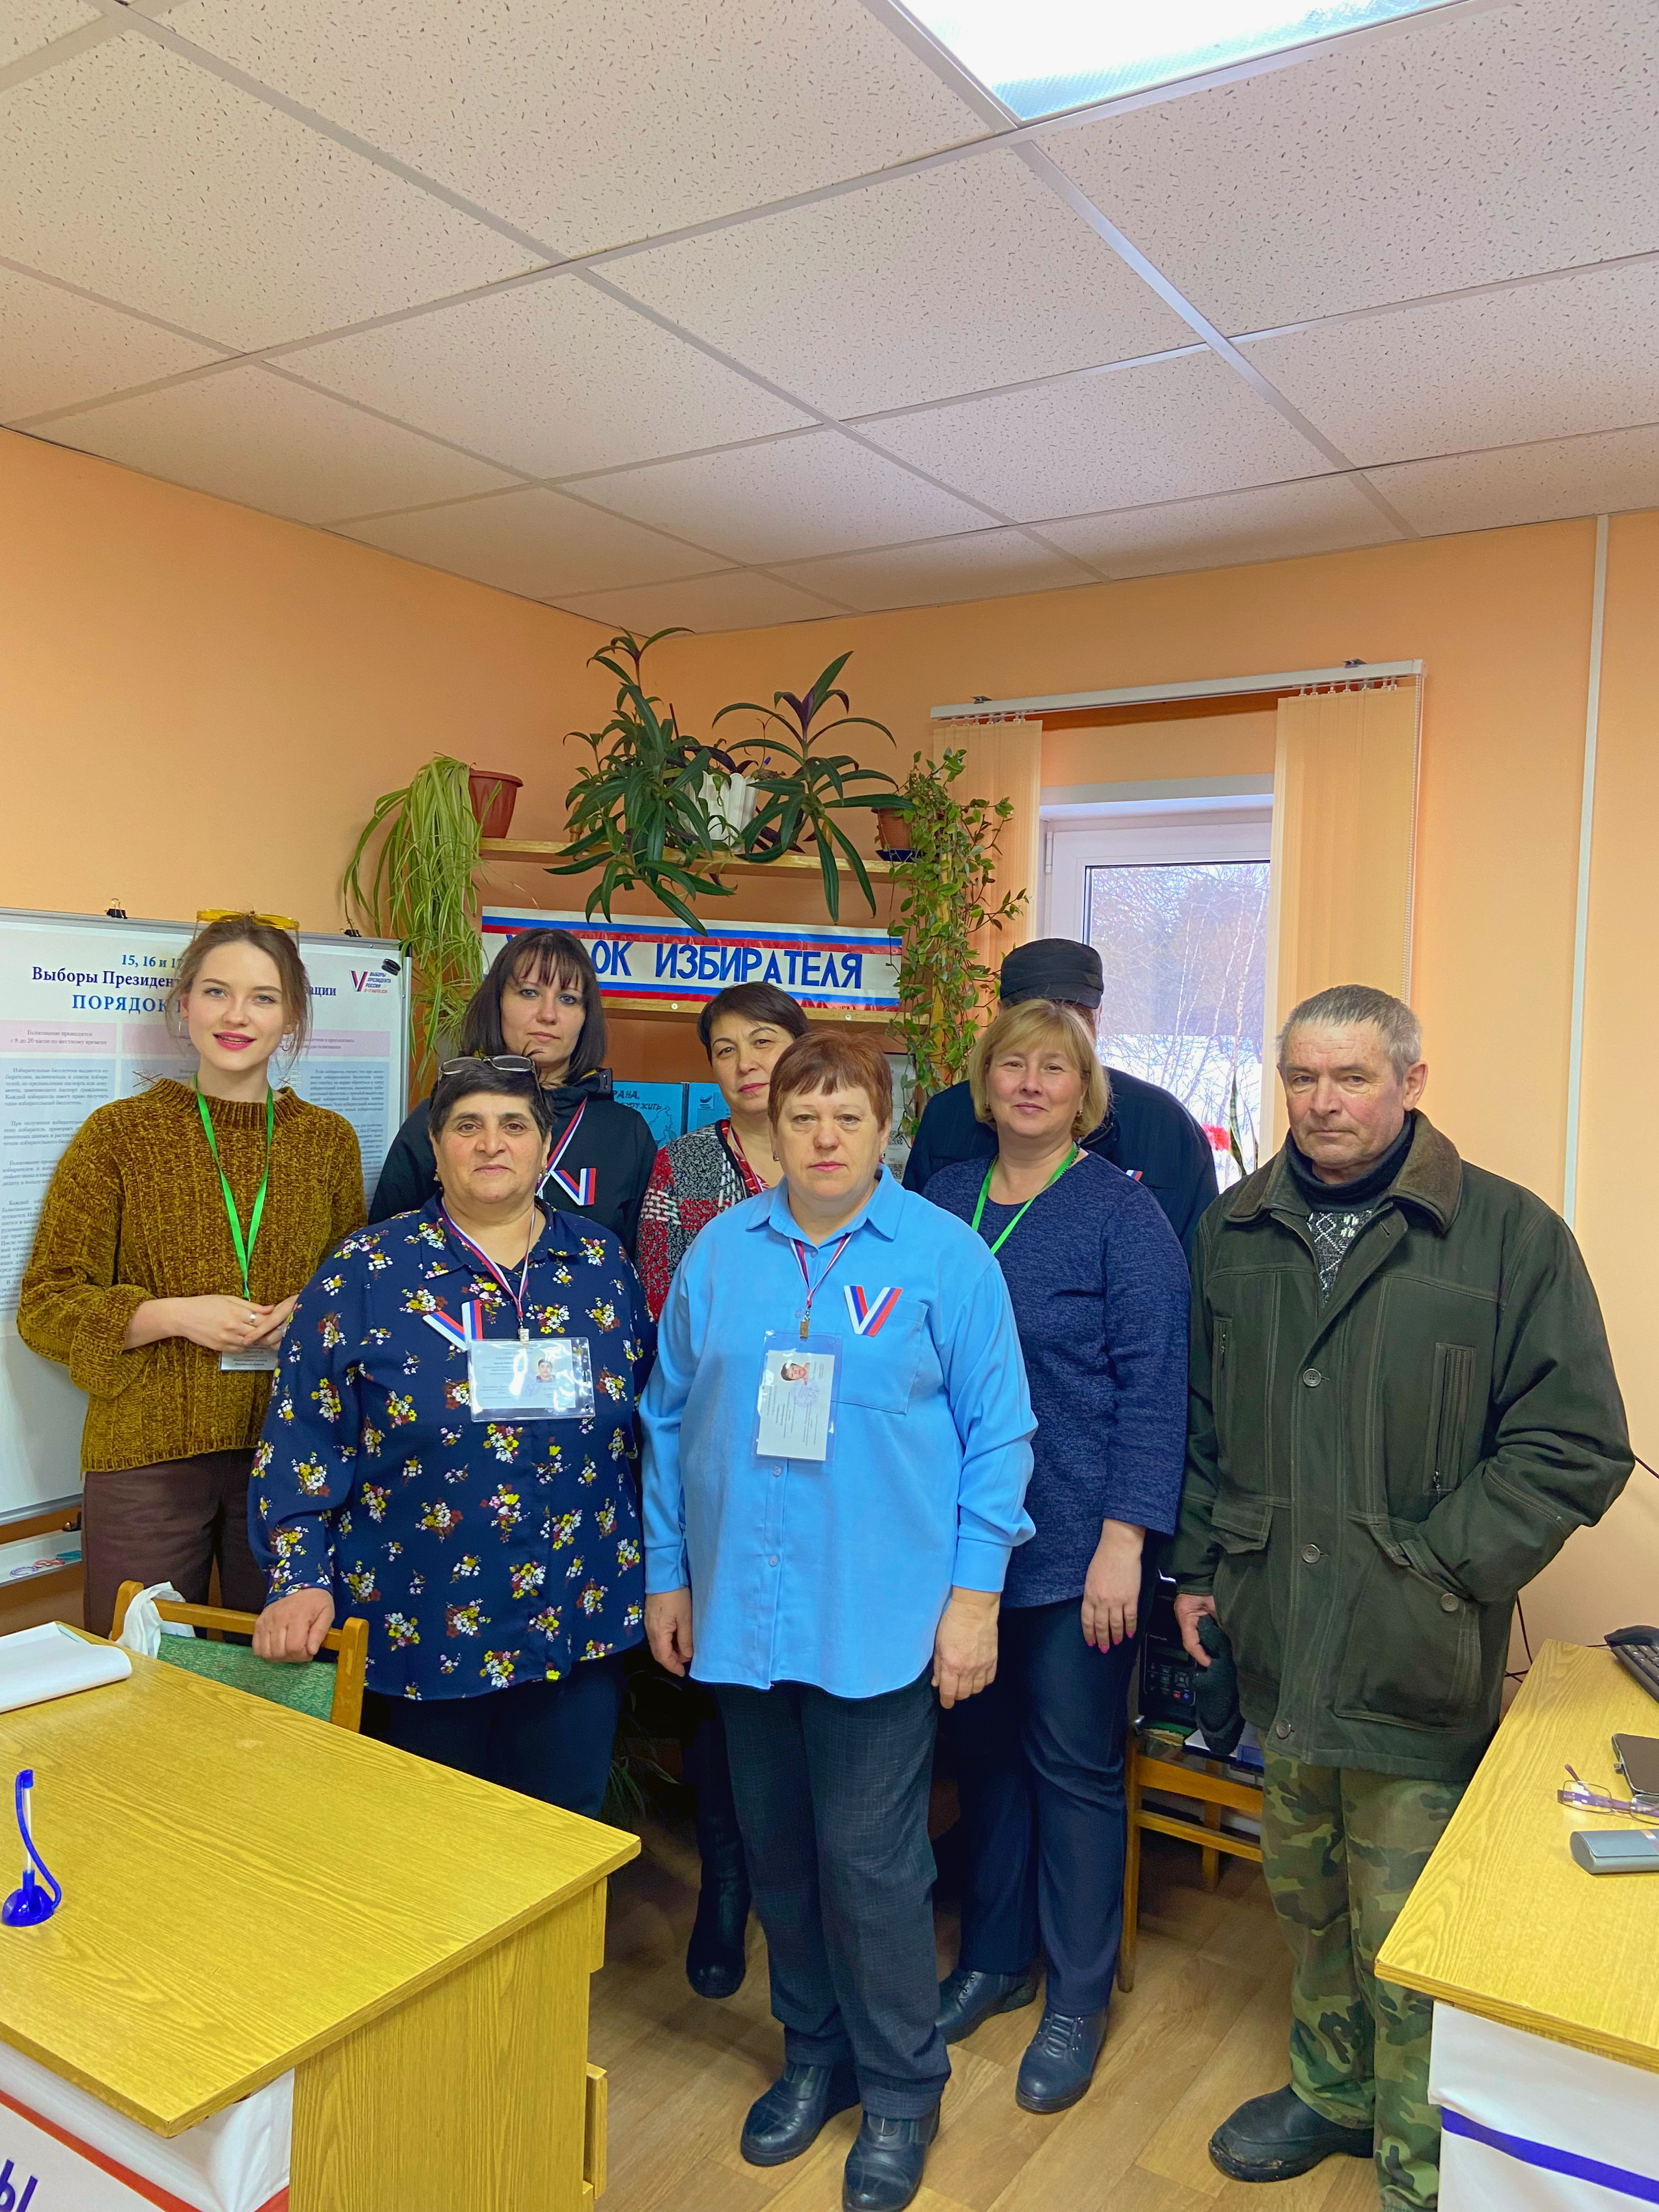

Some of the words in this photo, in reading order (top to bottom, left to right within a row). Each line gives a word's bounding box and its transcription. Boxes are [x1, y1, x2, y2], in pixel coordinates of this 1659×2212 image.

[122, 954, 138, 967] 15,
[143, 956, 156, 967] 16
[158, 959, 167, 968] и
[655, 942, 863, 989] ИЗБИРАТЕЛЯ
[32, 966, 98, 987] Выборы
